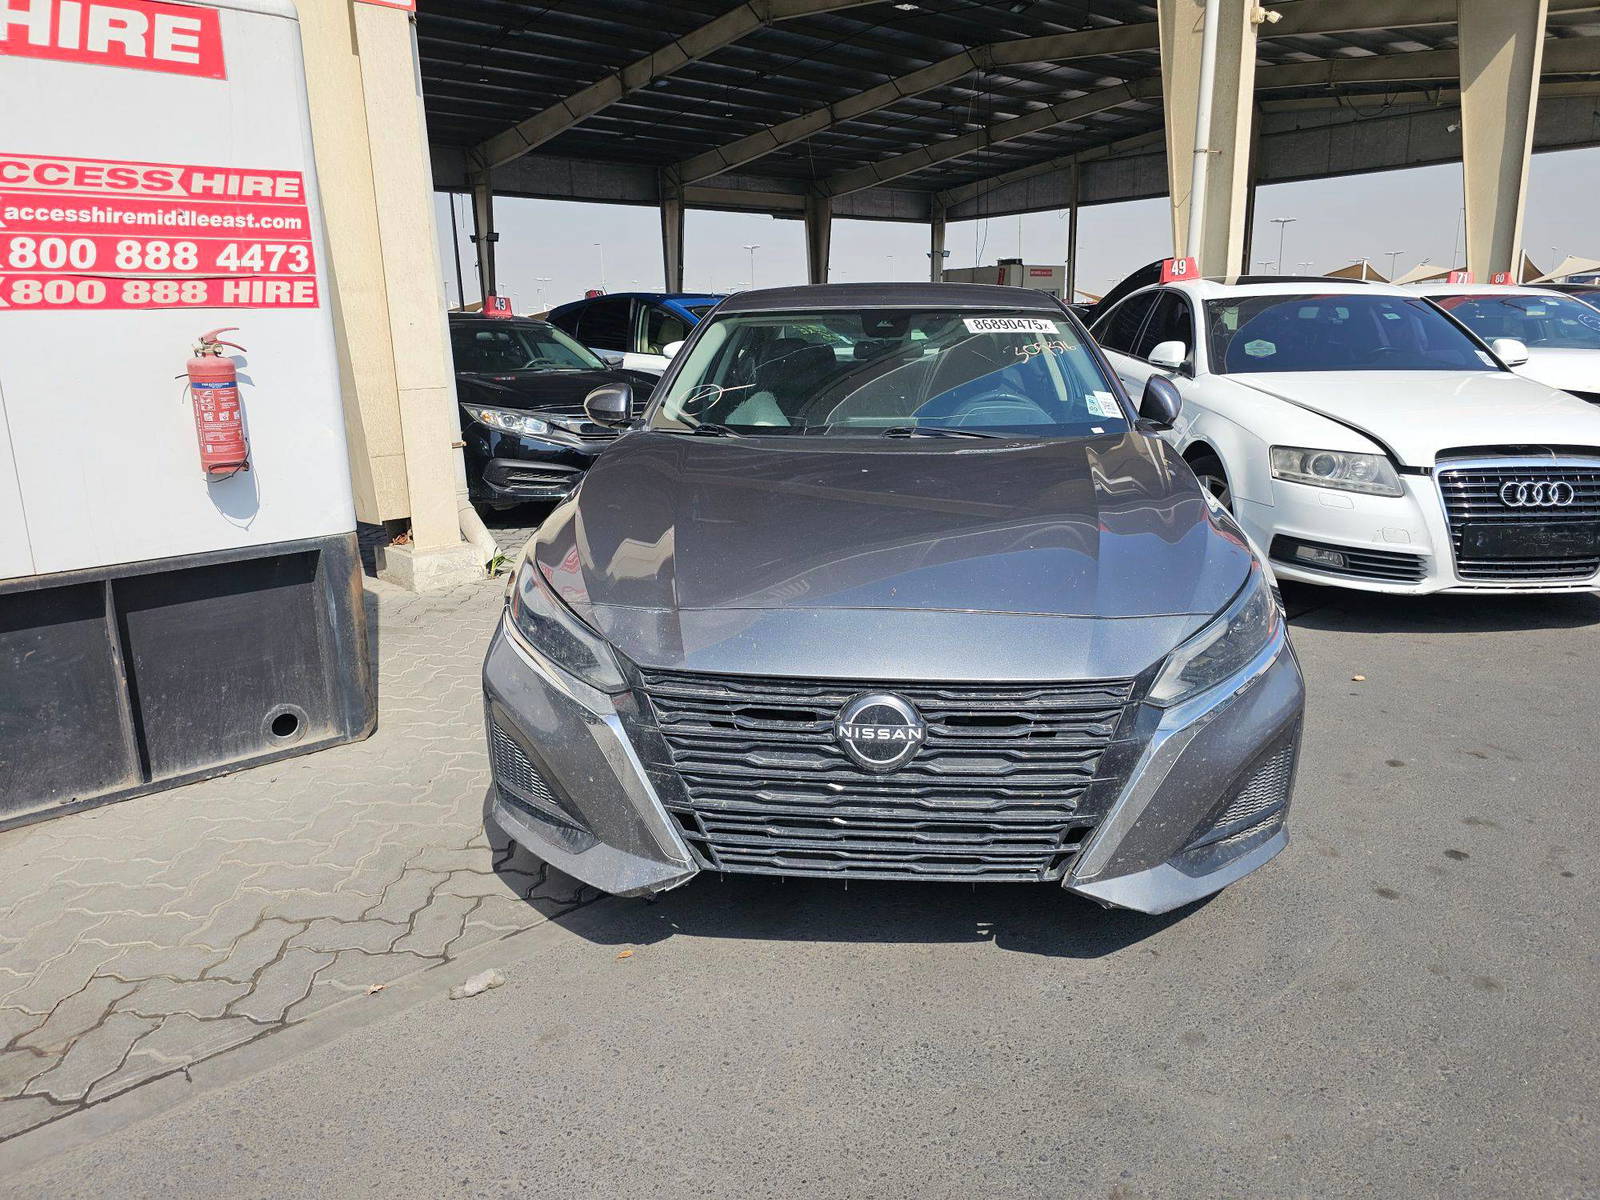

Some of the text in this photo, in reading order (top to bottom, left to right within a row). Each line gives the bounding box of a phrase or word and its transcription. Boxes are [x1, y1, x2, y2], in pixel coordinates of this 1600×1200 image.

[0, 0, 201, 64] HIRE
[190, 173, 301, 198] HIRE
[4, 206, 302, 229] accesshiremiddleeast.com
[8, 237, 309, 273] 800 888 4473
[1171, 259, 1187, 276] 49
[11, 280, 314, 304] 800 888 HIRE
[839, 726, 922, 740] NISSAN
